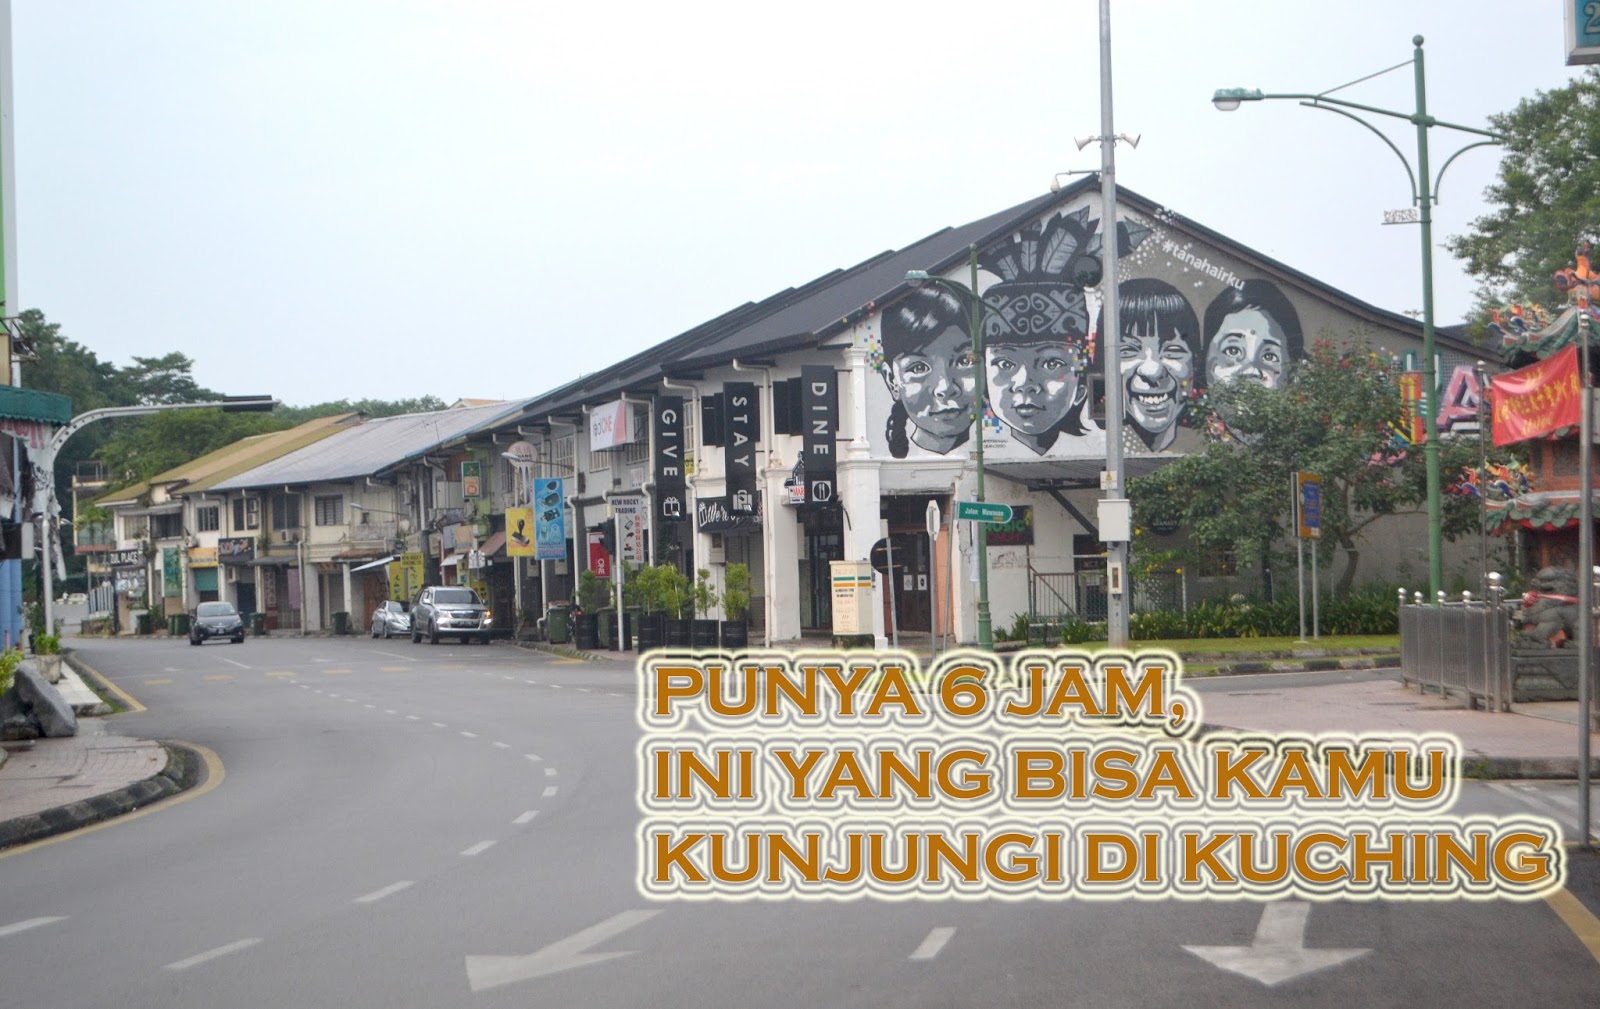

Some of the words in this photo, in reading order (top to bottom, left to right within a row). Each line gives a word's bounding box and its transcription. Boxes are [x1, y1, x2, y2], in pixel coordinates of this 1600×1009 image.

[1162, 239, 1245, 290] #tanahairku
[661, 408, 678, 477] GIVE
[731, 395, 749, 468] STAY
[811, 381, 829, 455] DINE
[964, 506, 978, 516] Jalan
